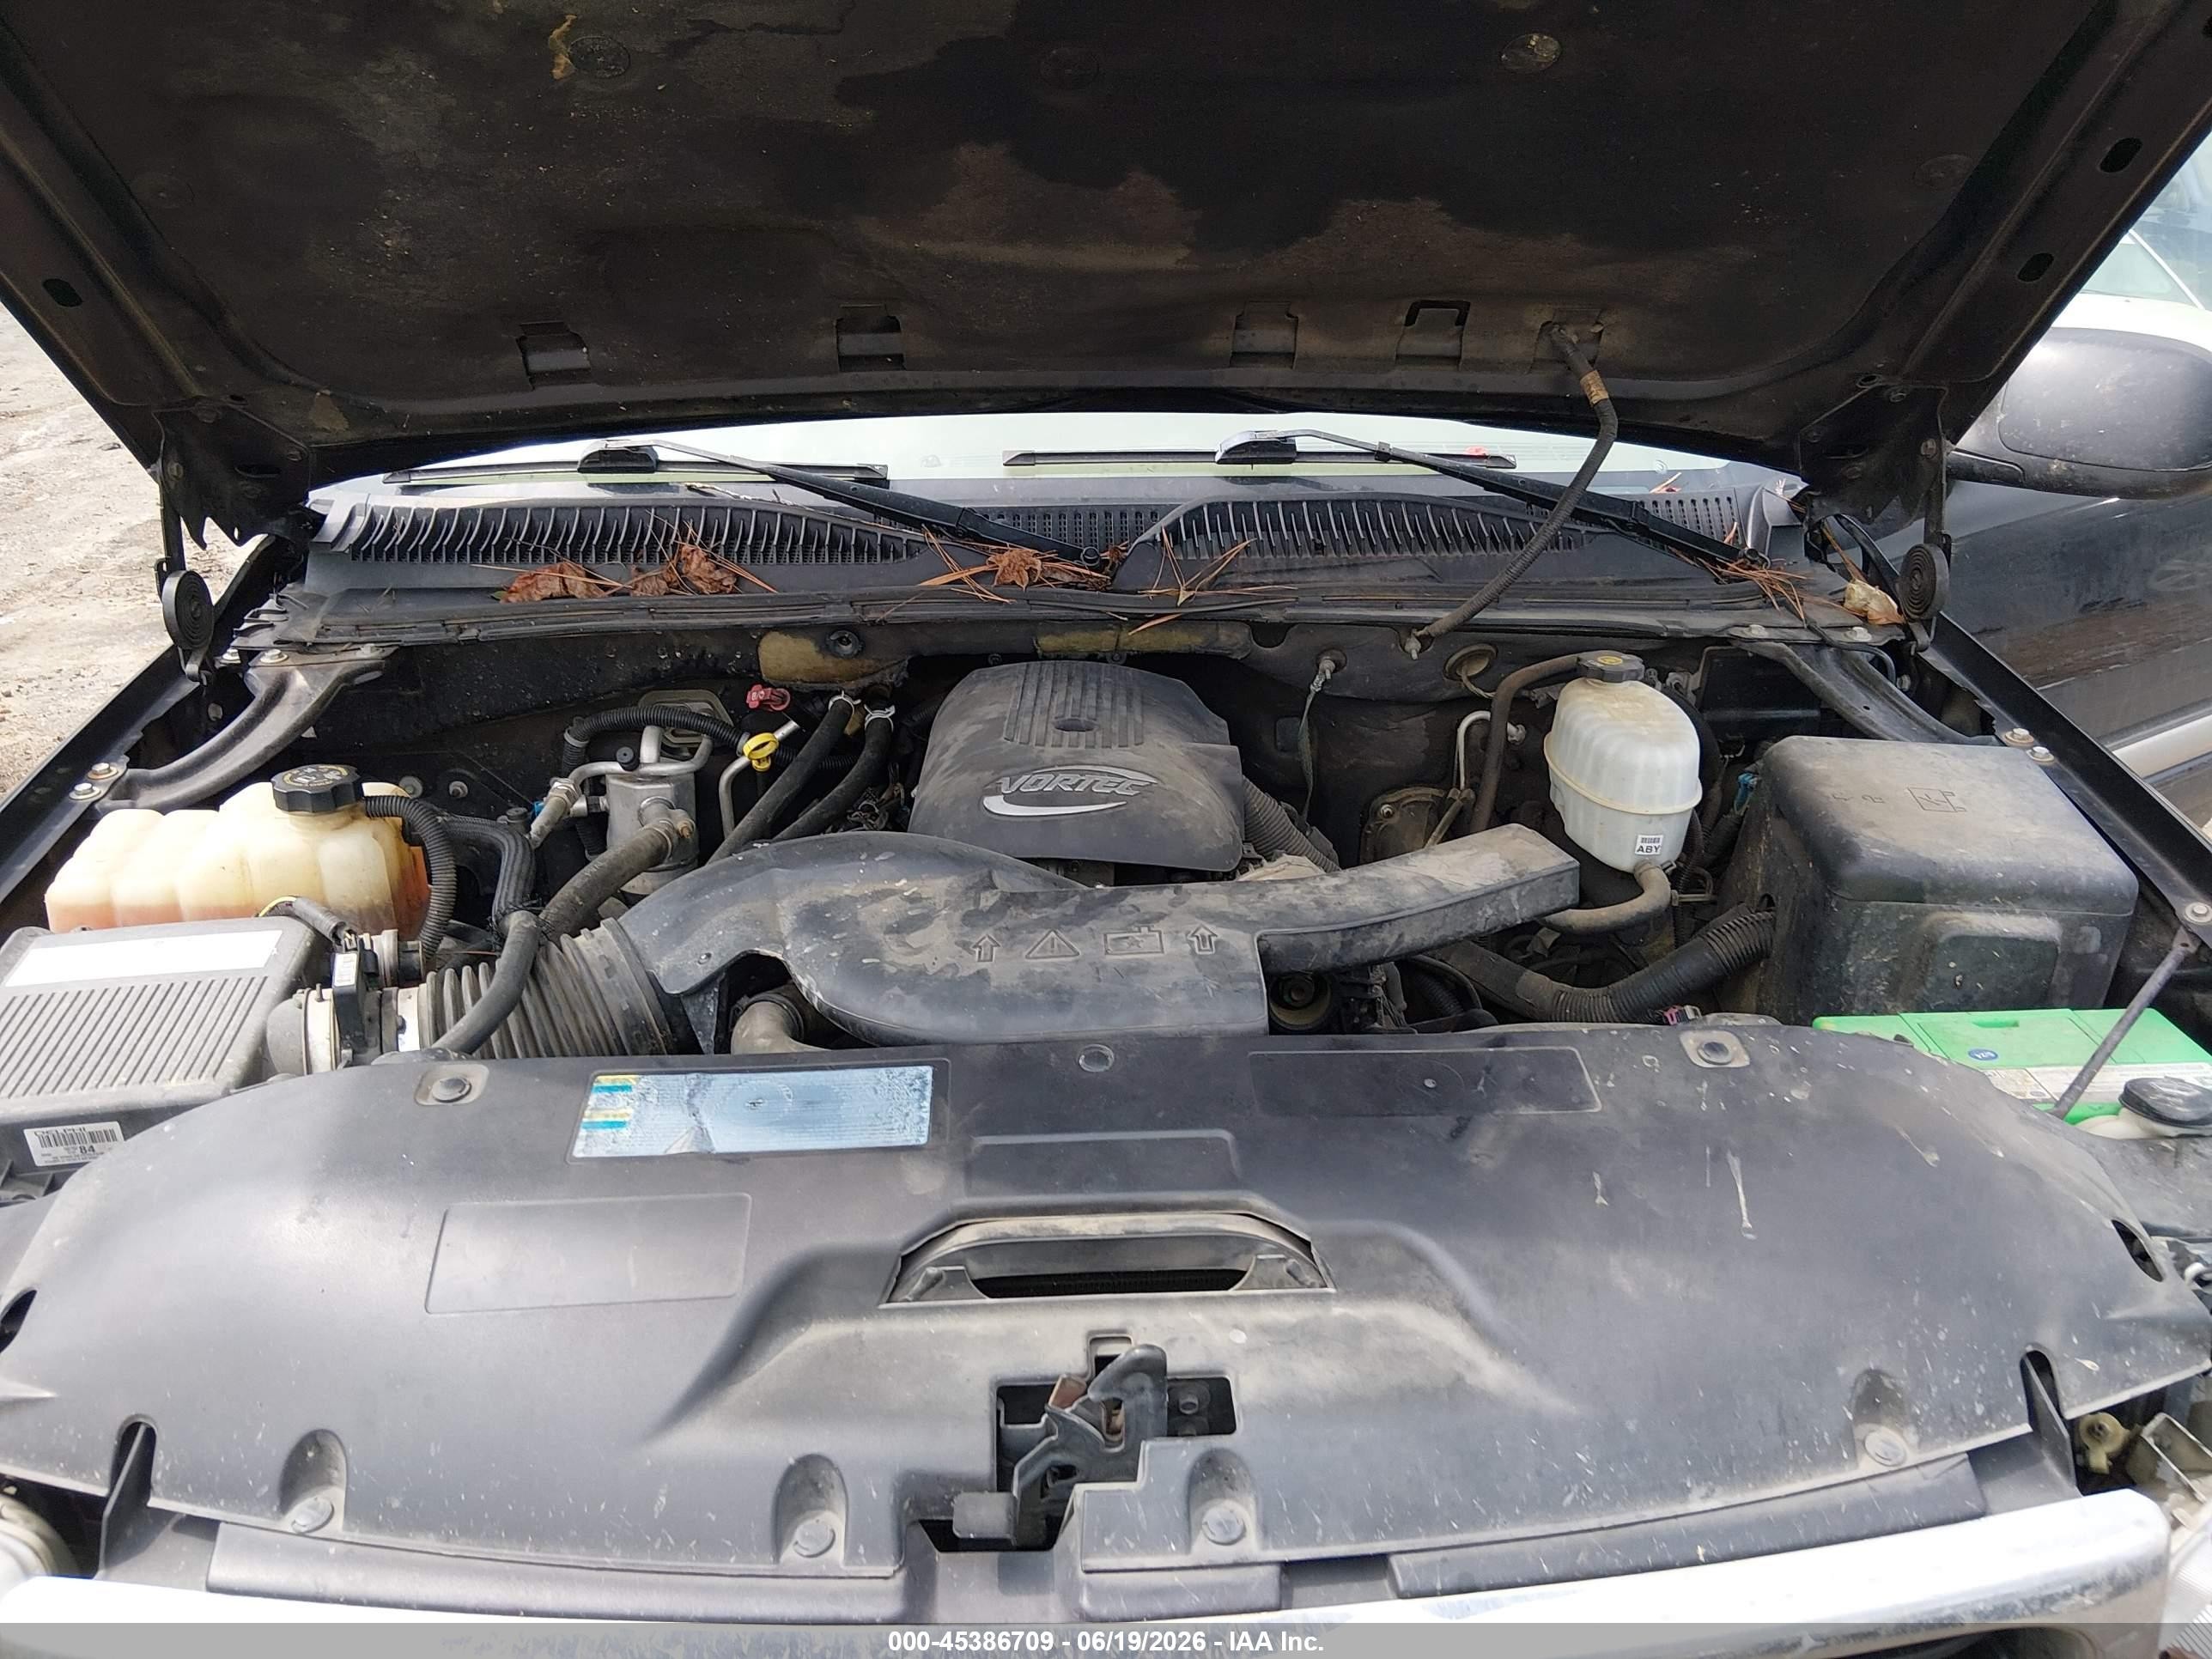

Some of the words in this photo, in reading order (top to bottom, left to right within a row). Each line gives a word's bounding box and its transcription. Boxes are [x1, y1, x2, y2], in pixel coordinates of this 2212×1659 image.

[996, 773, 1152, 797] VORTEC
[1637, 845, 1661, 854] ABY
[78, 1145, 95, 1154] 84
